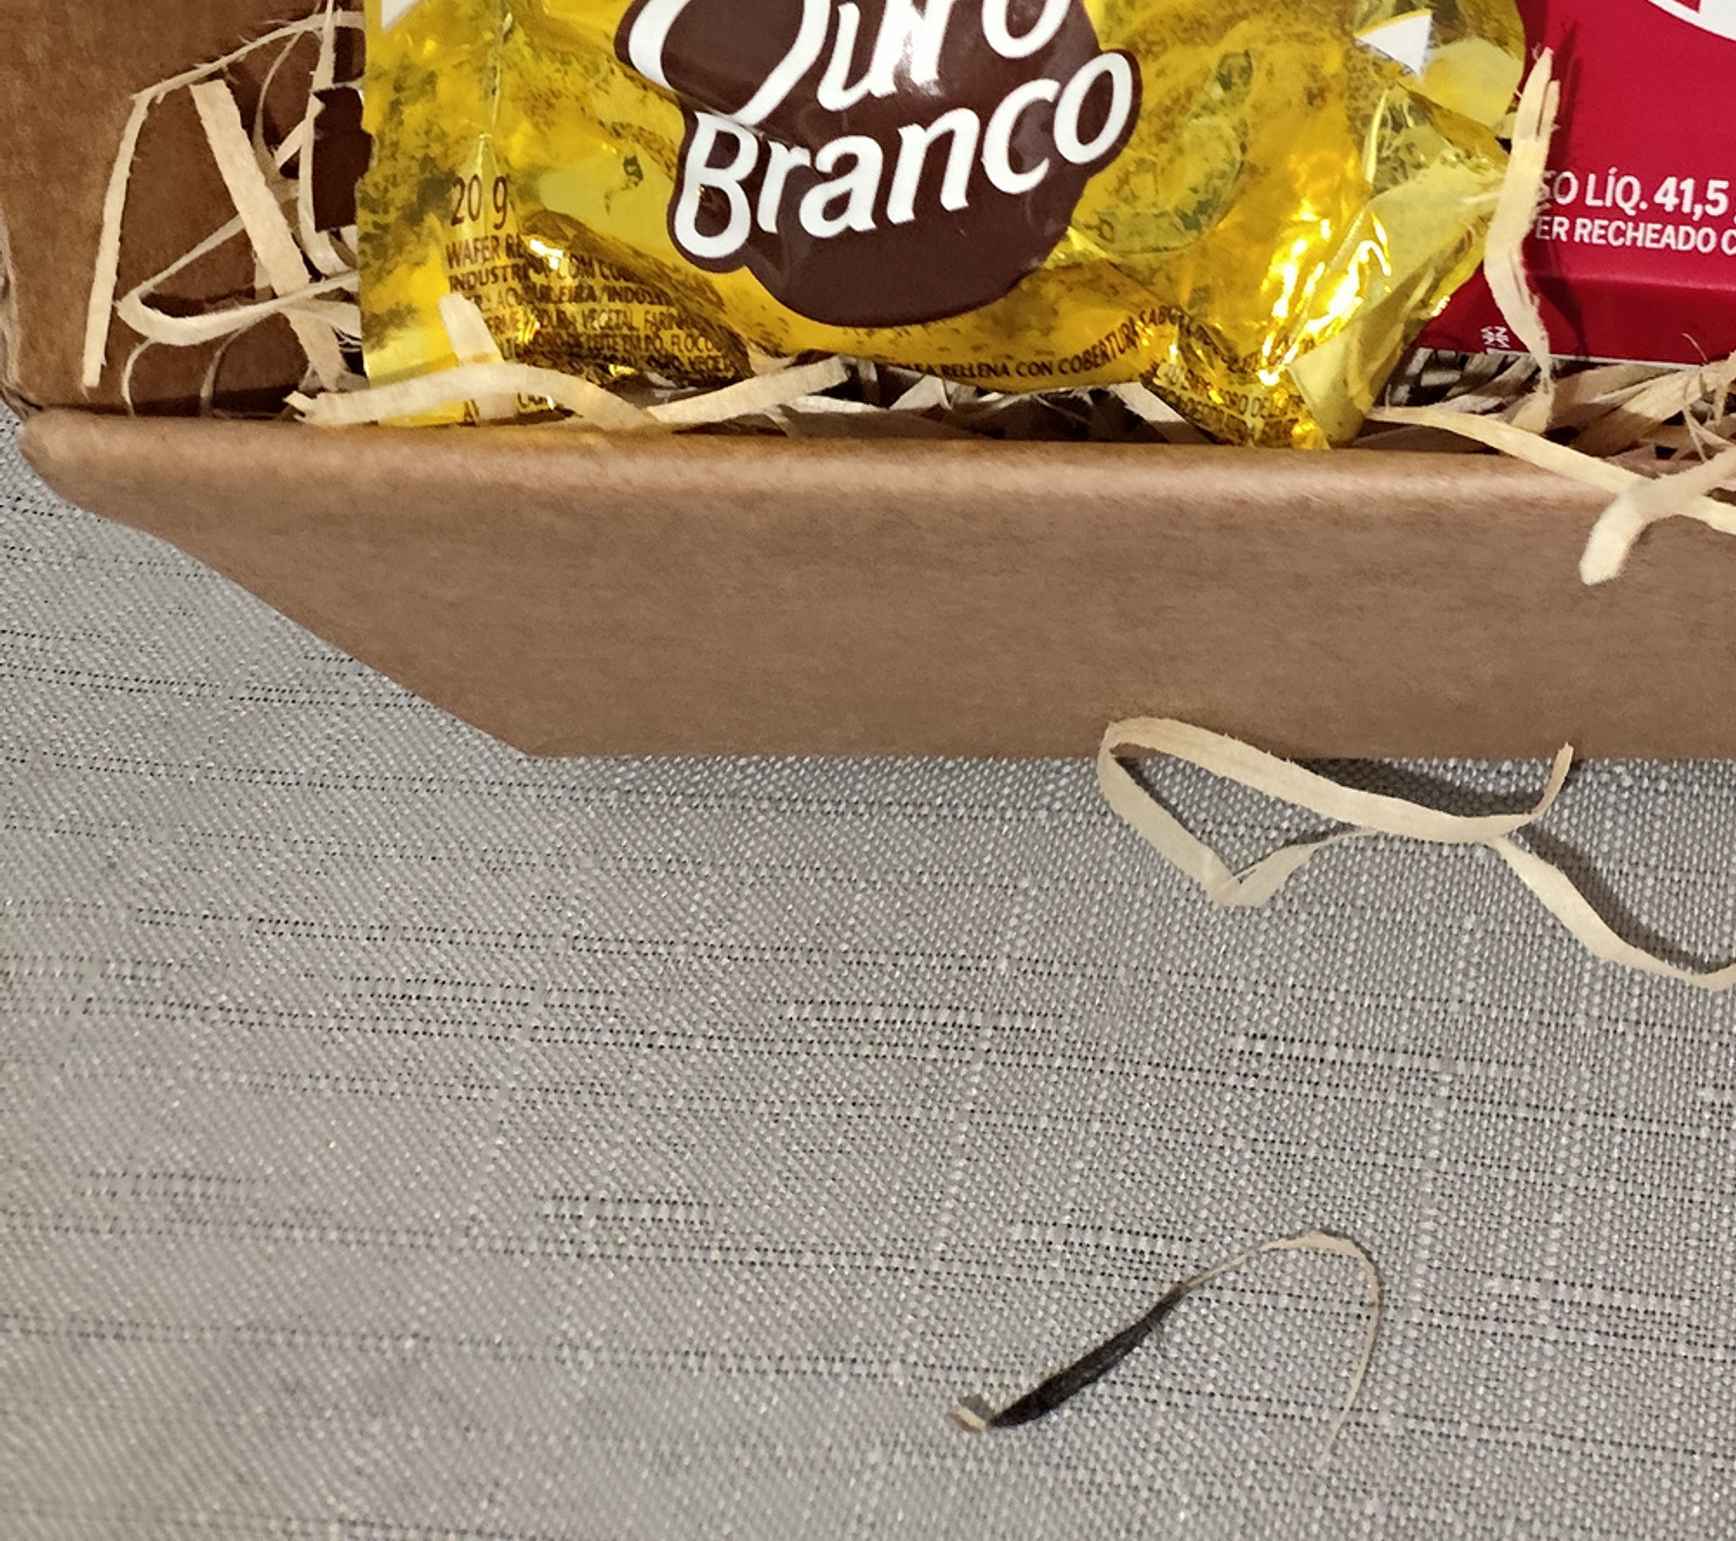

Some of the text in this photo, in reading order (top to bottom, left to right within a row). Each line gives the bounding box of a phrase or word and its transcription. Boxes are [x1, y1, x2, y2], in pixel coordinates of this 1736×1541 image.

[674, 52, 1133, 258] Branco
[450, 173, 483, 227] 20
[1585, 167, 1648, 216] LÍQ.
[1653, 176, 1730, 222] 41,5
[446, 235, 500, 271] WAFER
[1574, 218, 1716, 254] RECHEADO
[1016, 358, 1055, 379] CON
[1058, 313, 1140, 377] COBERTURA
